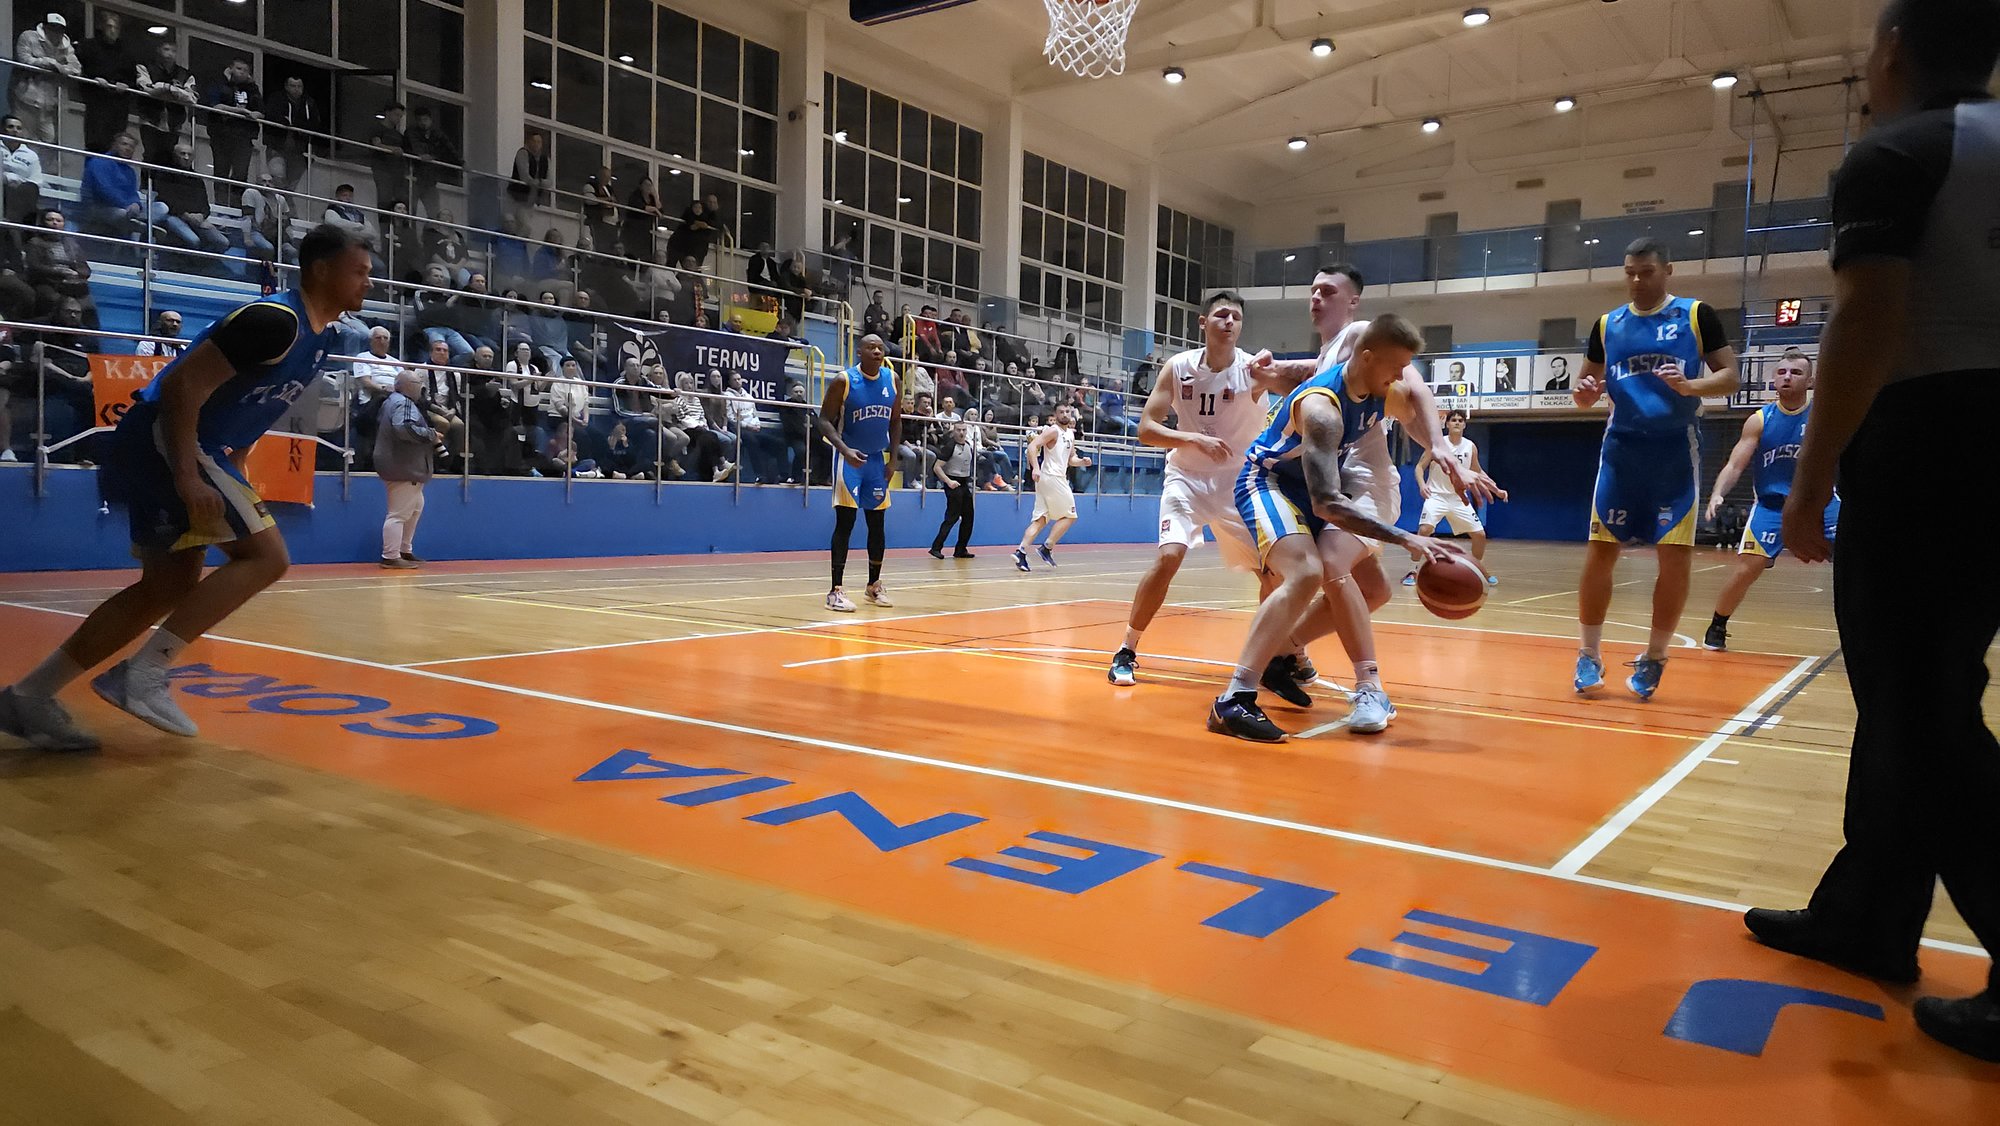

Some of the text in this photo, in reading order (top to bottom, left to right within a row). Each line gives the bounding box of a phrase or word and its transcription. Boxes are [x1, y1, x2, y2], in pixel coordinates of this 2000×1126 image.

[1656, 323, 1678, 341] 12
[695, 345, 760, 372] TERMY
[881, 386, 890, 398] 4
[1199, 393, 1216, 416] 11
[852, 486, 859, 497] 4
[1606, 508, 1628, 526] 12
[1760, 531, 1777, 544] 10
[575, 747, 1886, 1057] JELENIA
